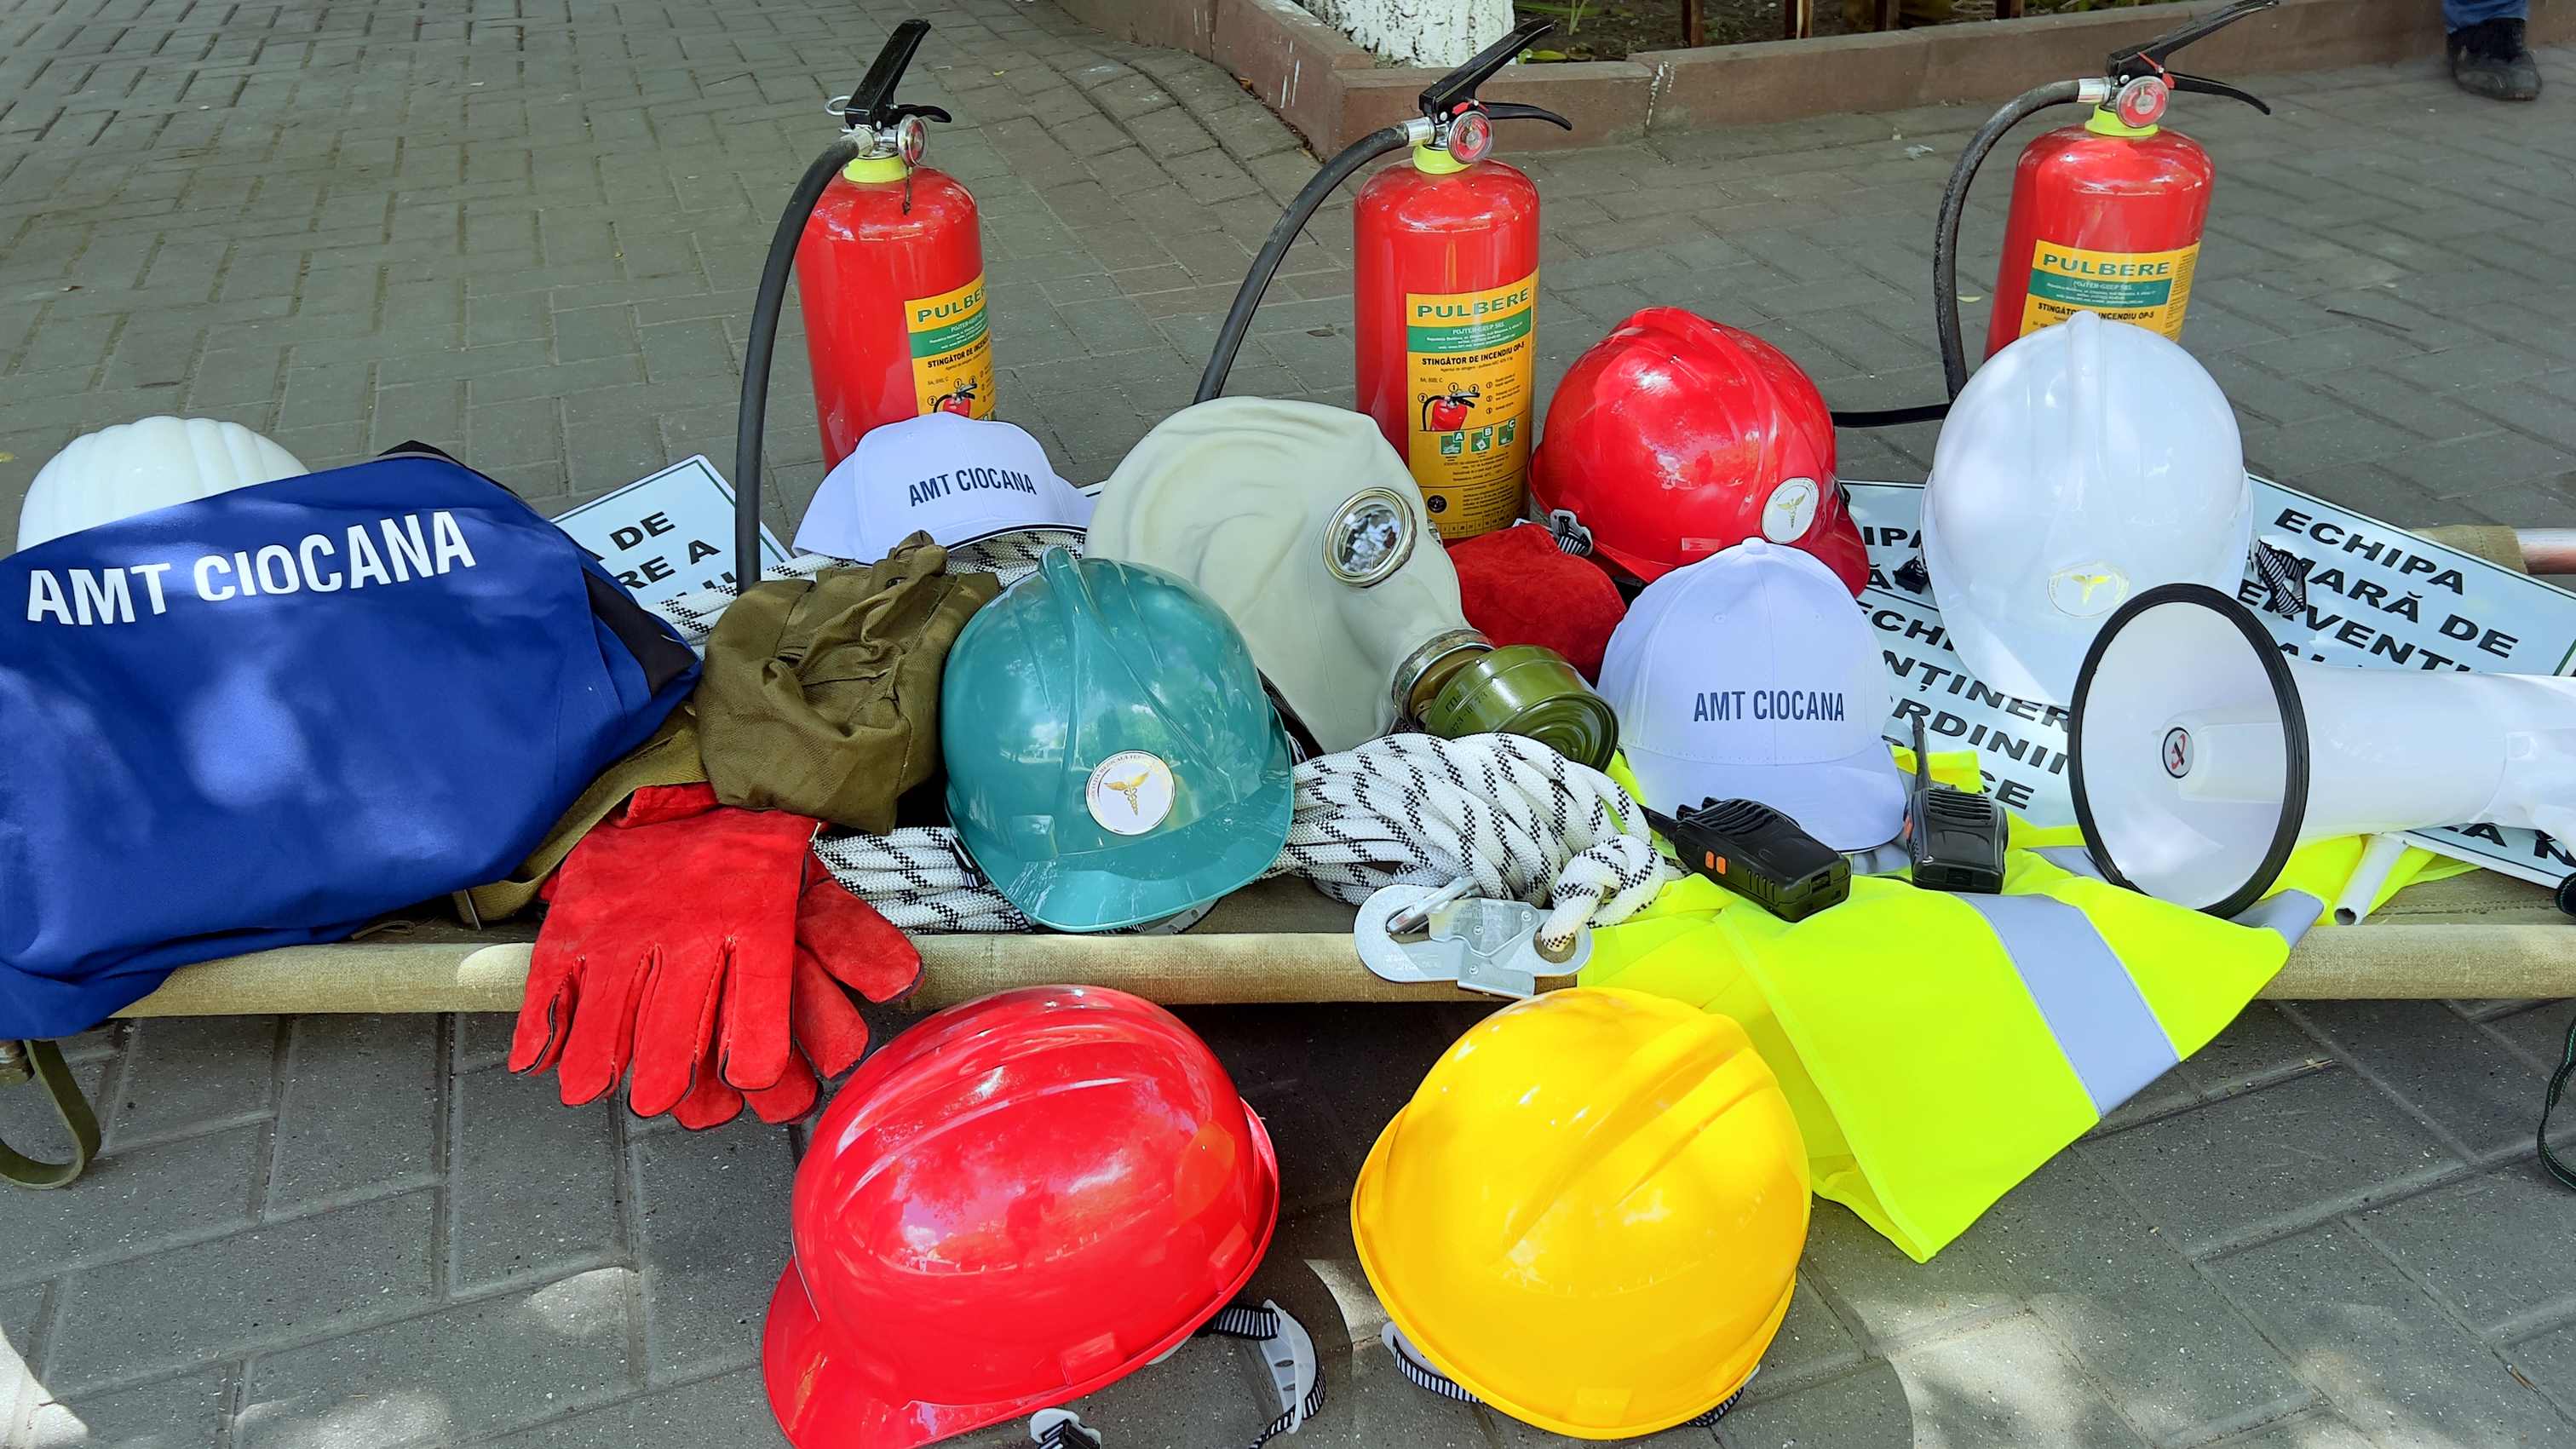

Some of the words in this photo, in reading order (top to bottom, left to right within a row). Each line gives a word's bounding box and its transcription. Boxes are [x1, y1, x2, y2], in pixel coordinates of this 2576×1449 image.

[2042, 252, 2171, 277] PULBERE
[1417, 287, 1528, 318] PULBERE
[909, 474, 951, 507] AMT
[956, 467, 1038, 495] CIOCANA
[609, 511, 676, 551] DE
[27, 562, 170, 626] AMT
[193, 511, 477, 601] CIOCANA
[687, 539, 722, 565] A
[2274, 508, 2464, 595] ECHIPA
[2300, 557, 2424, 624] ARĂ
[2439, 613, 2519, 658] DE
[1693, 691, 1745, 722] AMT
[1753, 690, 1844, 722] CIOCANA
